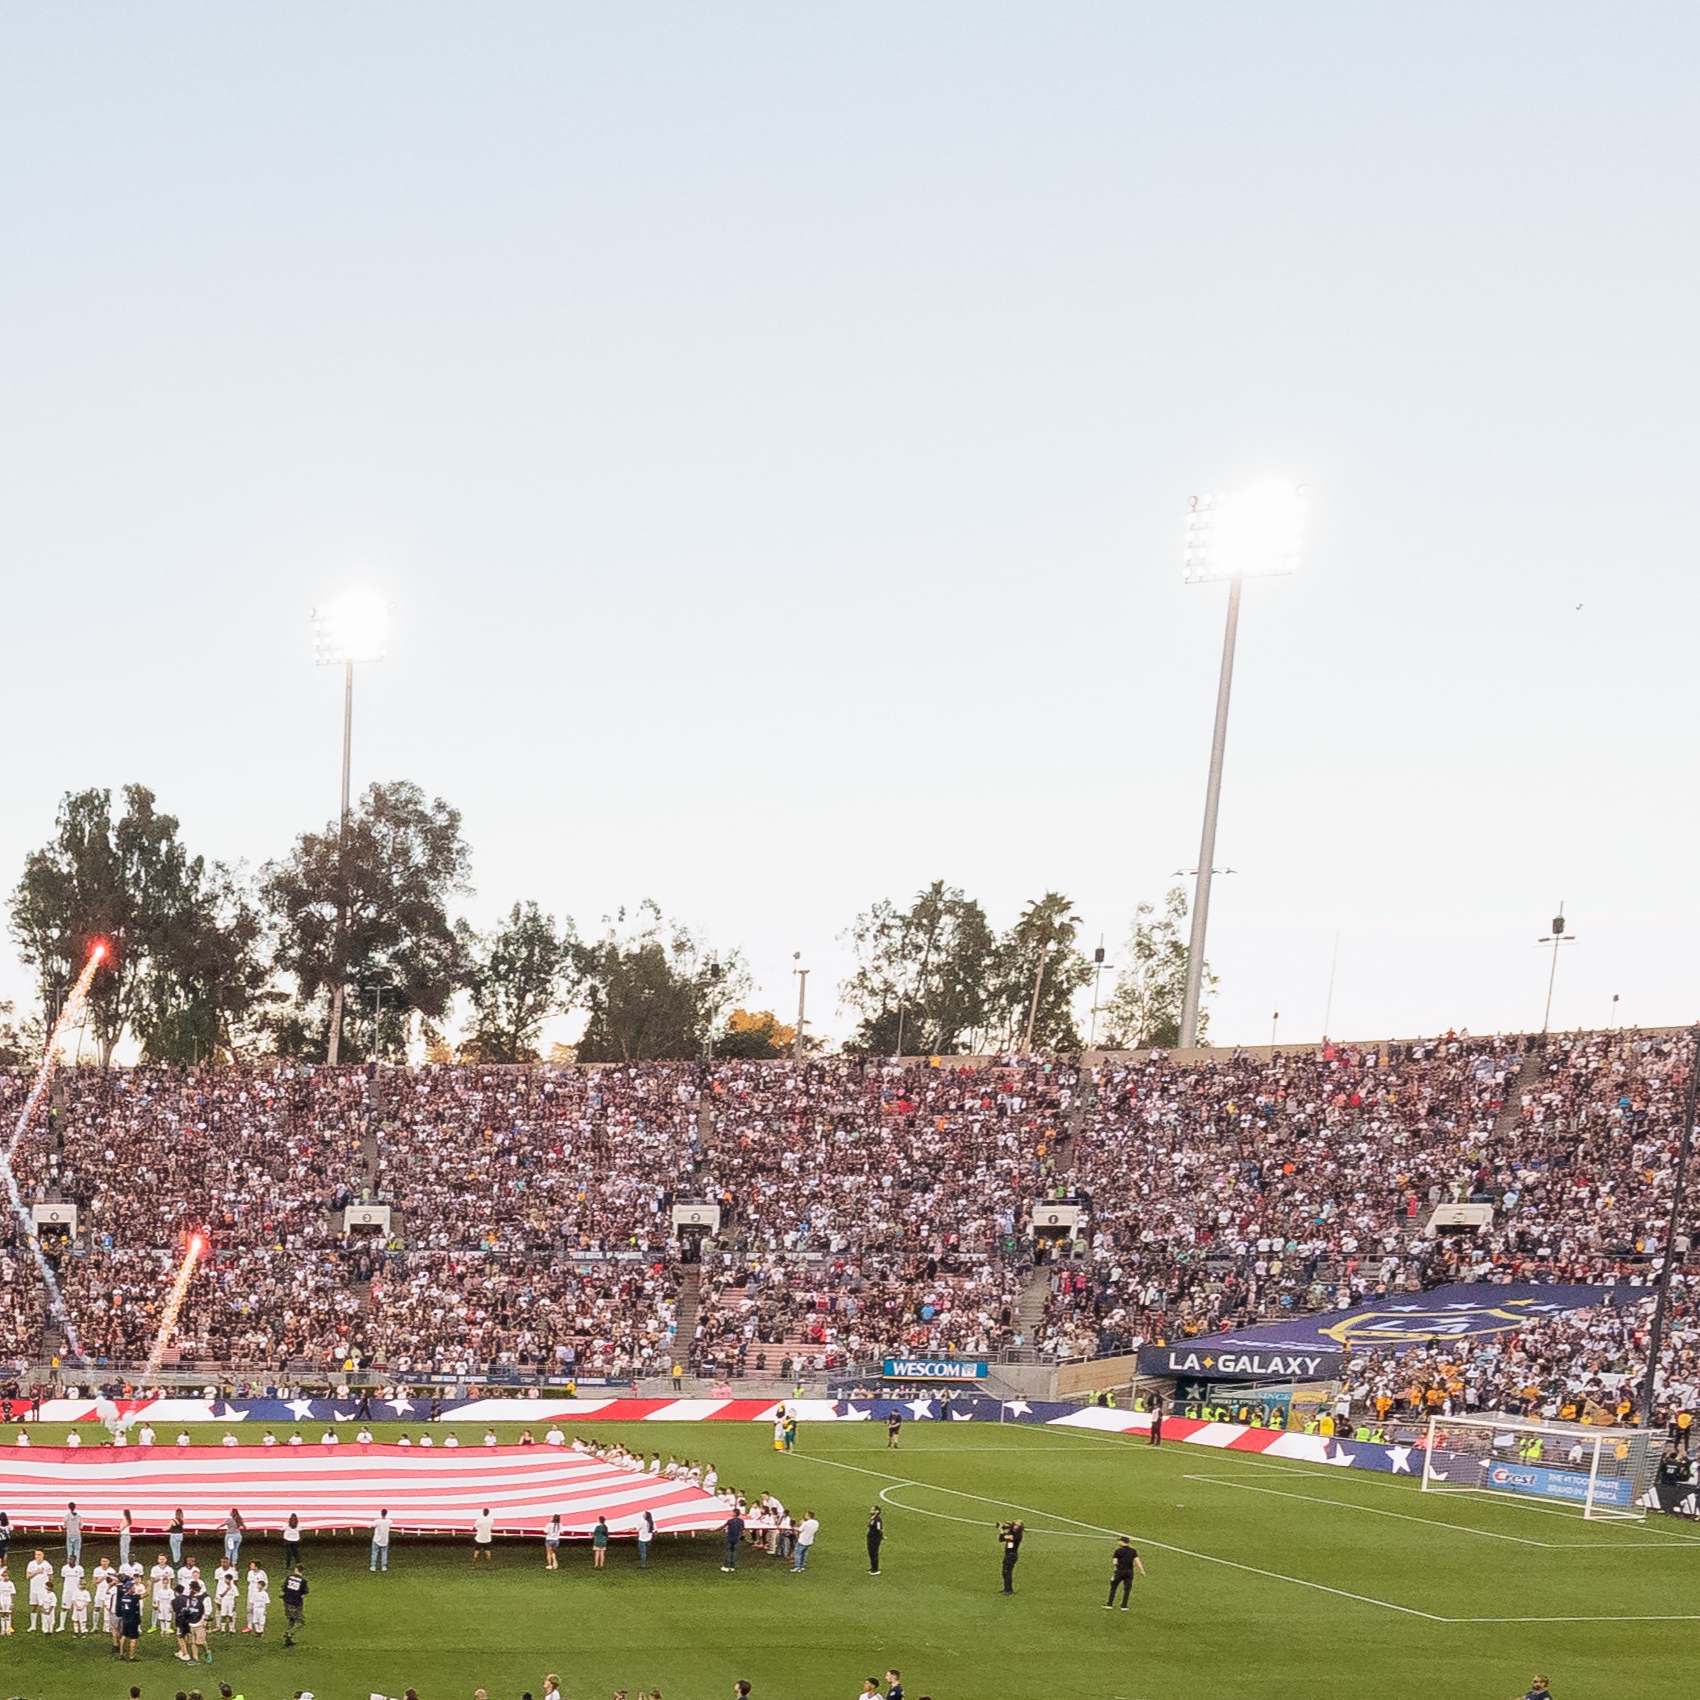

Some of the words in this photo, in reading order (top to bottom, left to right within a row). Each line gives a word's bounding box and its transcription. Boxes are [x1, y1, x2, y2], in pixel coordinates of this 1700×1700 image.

[893, 1362, 960, 1377] WESCOM
[1169, 1352, 1201, 1372] LA
[1217, 1354, 1321, 1375] GALAXY
[1492, 1468, 1537, 1486] Crest
